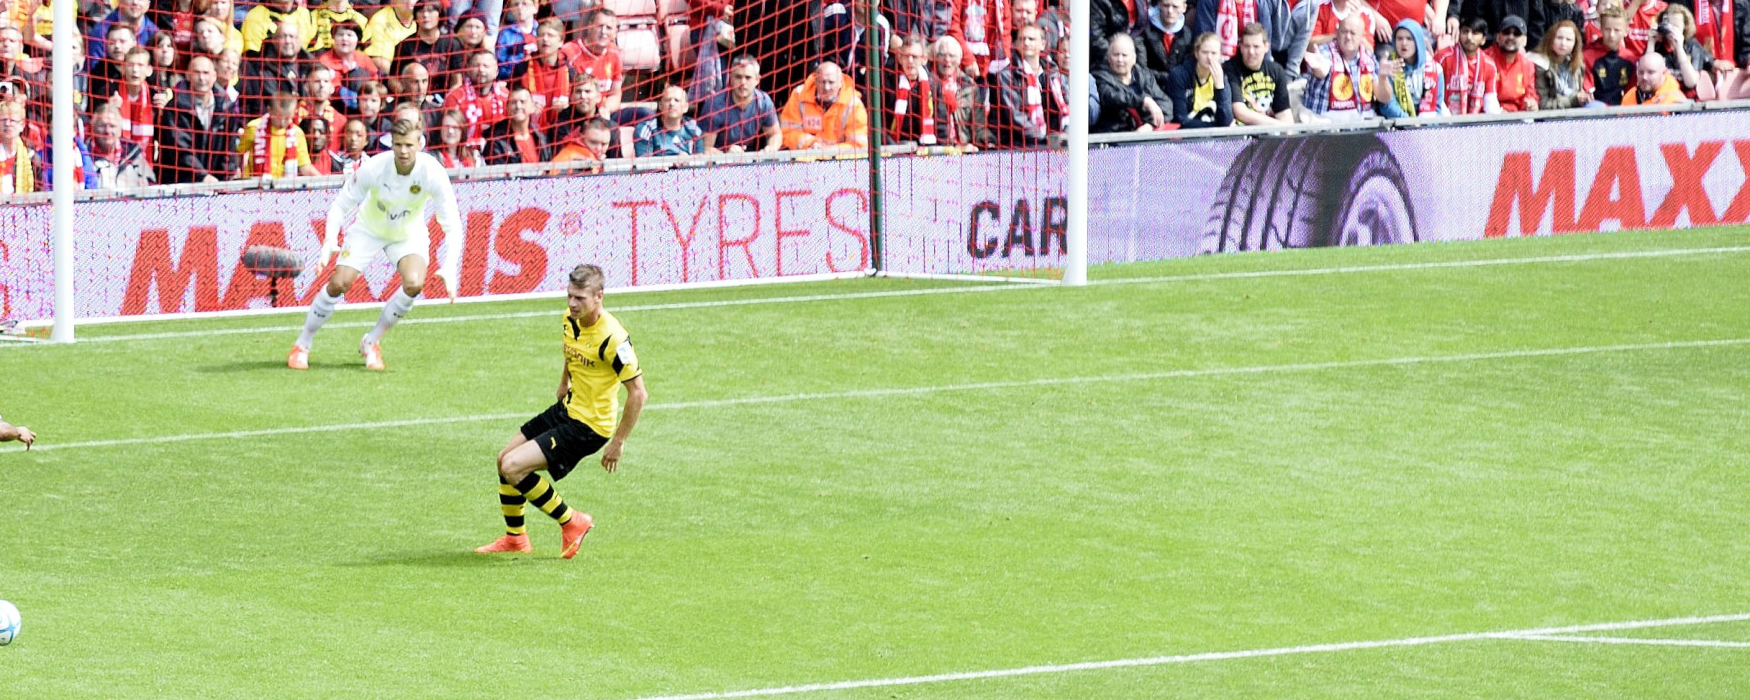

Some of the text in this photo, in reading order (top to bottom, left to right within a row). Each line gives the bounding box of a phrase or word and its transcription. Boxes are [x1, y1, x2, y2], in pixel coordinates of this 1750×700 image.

[613, 188, 869, 286] TYRES
[968, 196, 1068, 259] CAR
[1484, 139, 1750, 239] MAX
